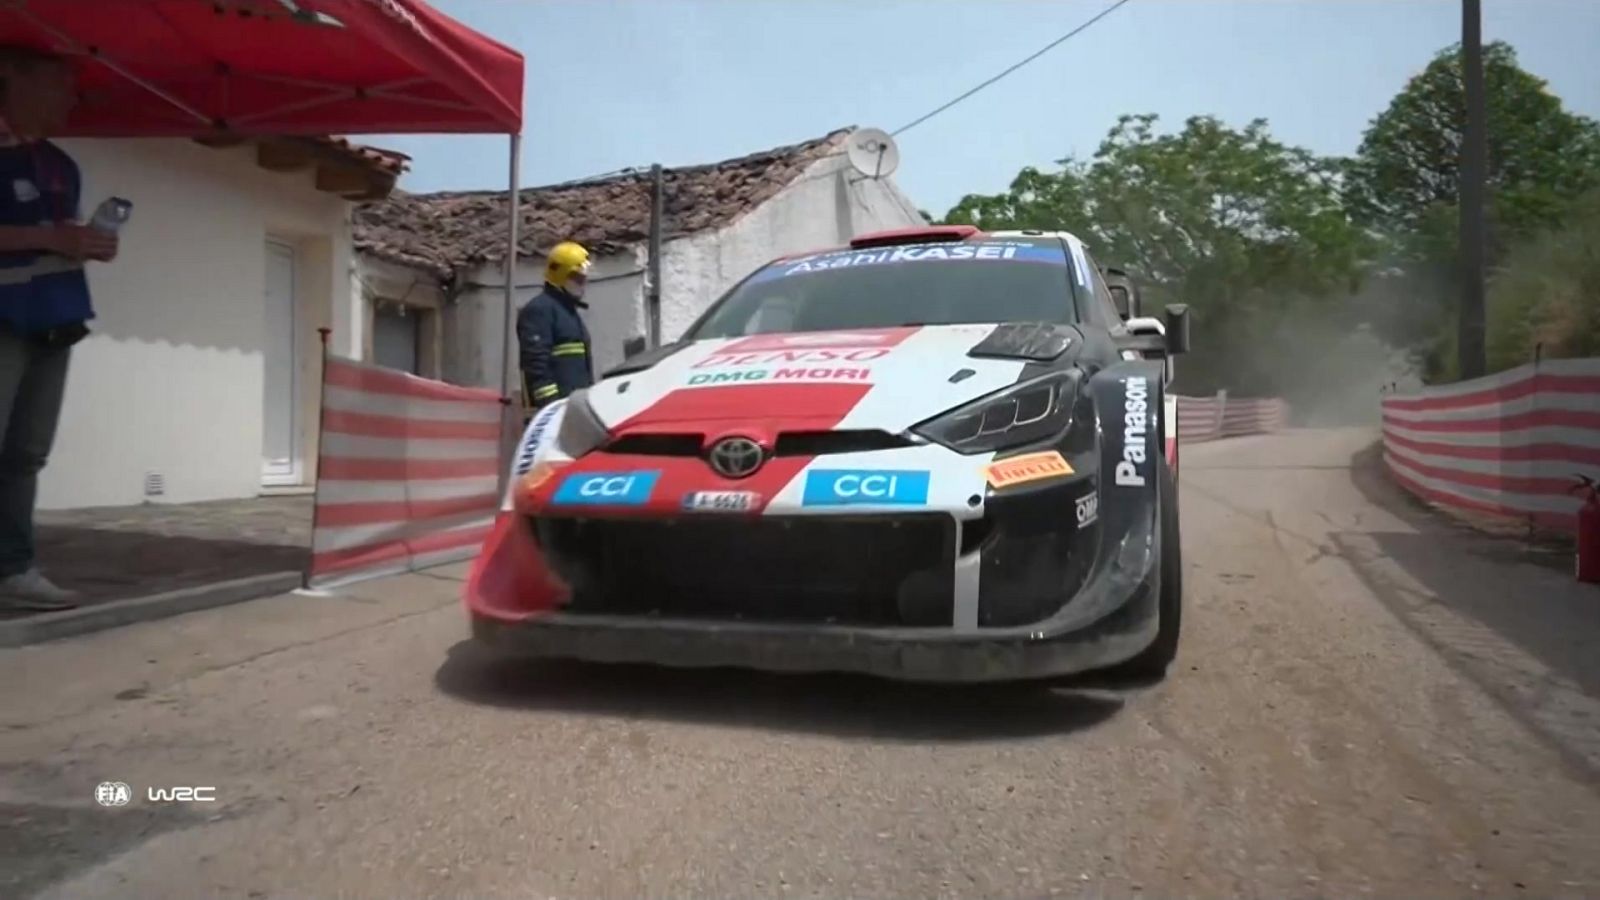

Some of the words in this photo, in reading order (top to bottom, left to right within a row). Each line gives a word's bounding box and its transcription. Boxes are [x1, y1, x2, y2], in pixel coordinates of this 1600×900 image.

[691, 350, 890, 369] DENSO
[688, 369, 768, 385] DMG
[774, 368, 872, 380] MORI
[580, 476, 637, 497] CCI
[833, 474, 898, 498] CCI
